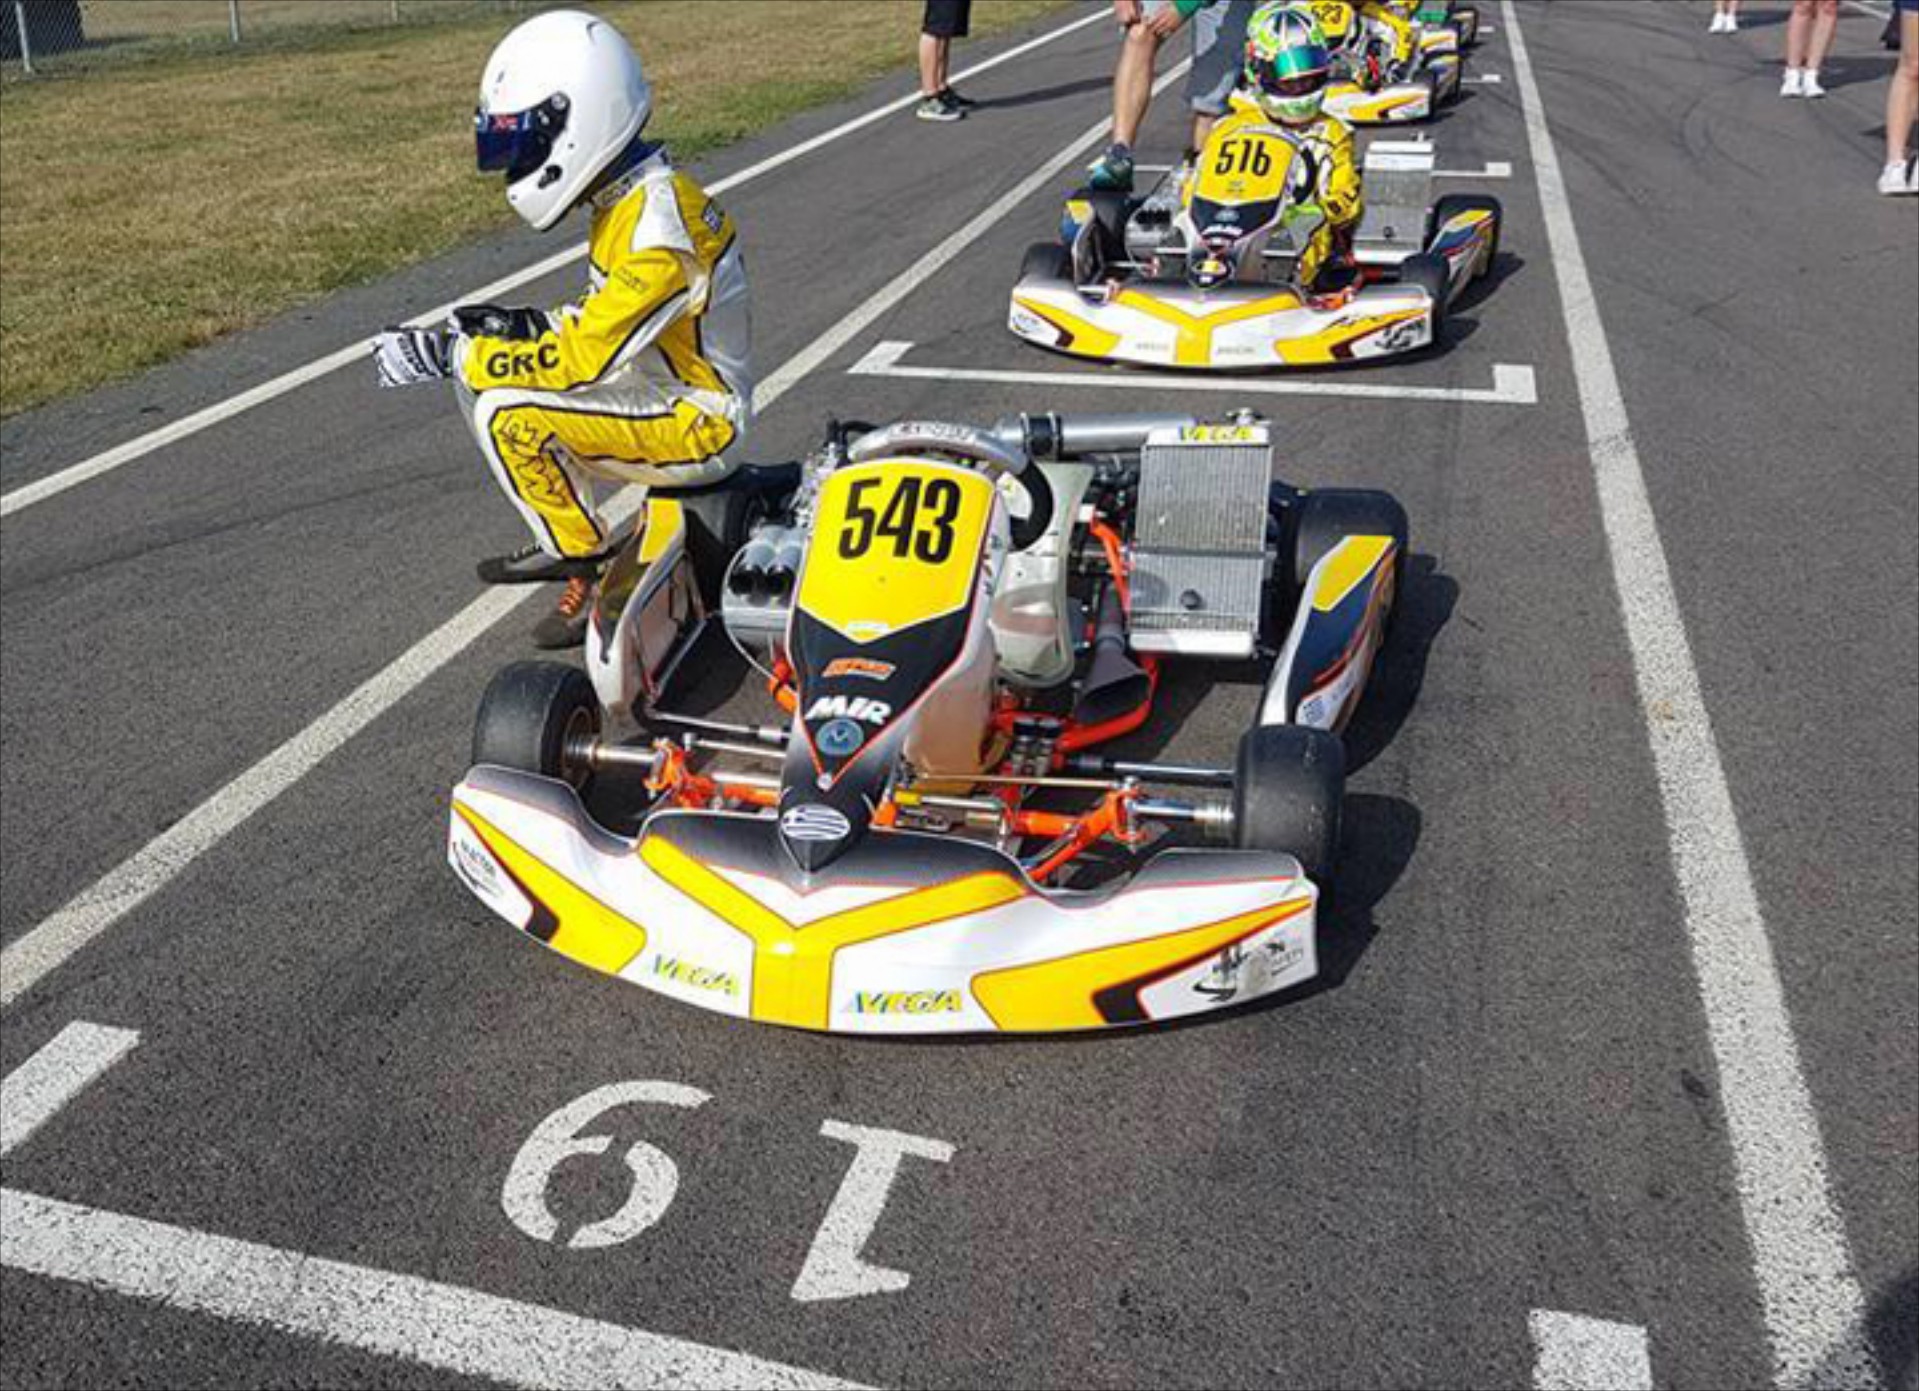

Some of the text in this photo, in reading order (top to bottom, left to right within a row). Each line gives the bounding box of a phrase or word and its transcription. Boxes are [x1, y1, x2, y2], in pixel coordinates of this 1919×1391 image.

[1214, 138, 1271, 176] 516
[838, 476, 961, 565] 543
[649, 952, 741, 997] VEGA
[850, 989, 963, 1015] VEGA
